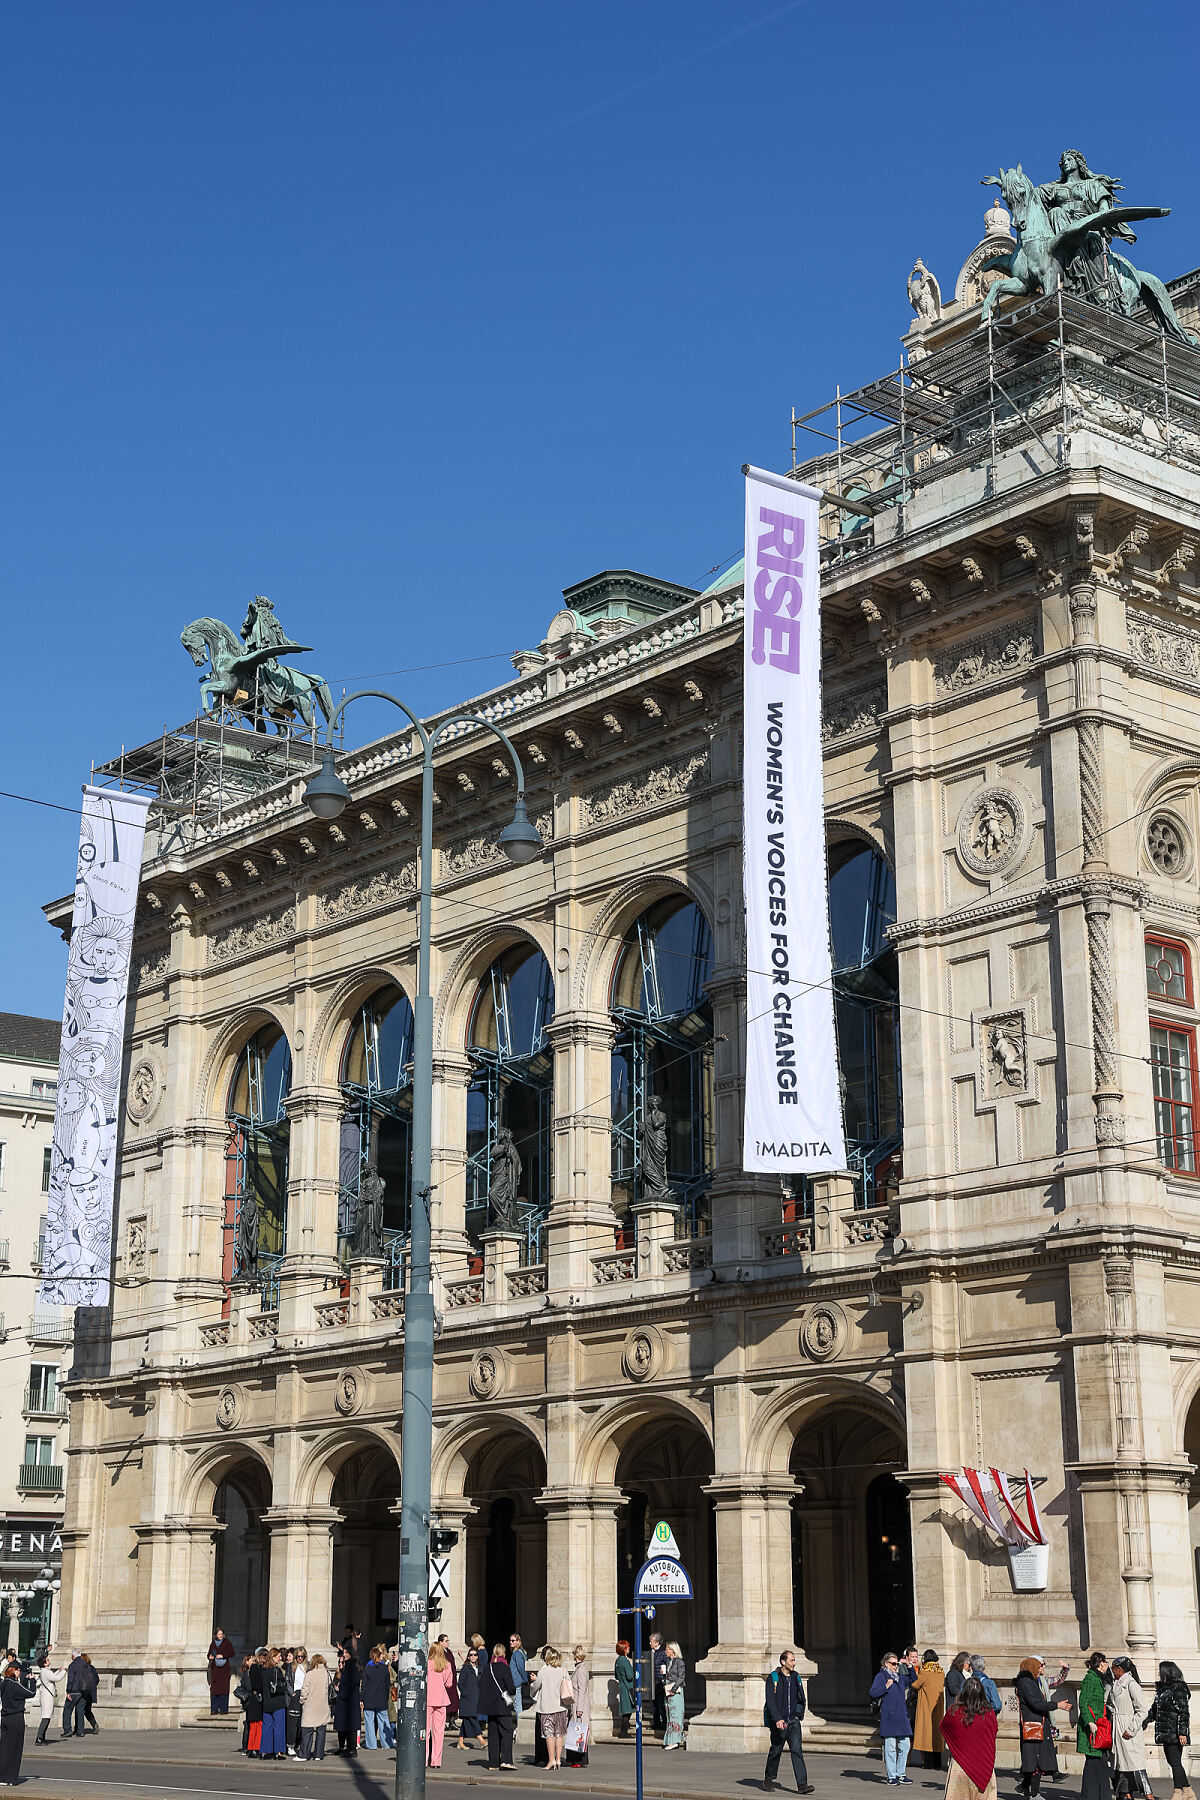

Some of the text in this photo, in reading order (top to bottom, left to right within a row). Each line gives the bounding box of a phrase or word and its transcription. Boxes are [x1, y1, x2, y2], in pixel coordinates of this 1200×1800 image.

[766, 701, 799, 1105] WOMEN'S VOICES FOR CHANGE
[659, 1525, 667, 1538] H
[649, 1561, 681, 1577] AUTOBUS
[643, 1584, 685, 1594] HALTESTELLE
